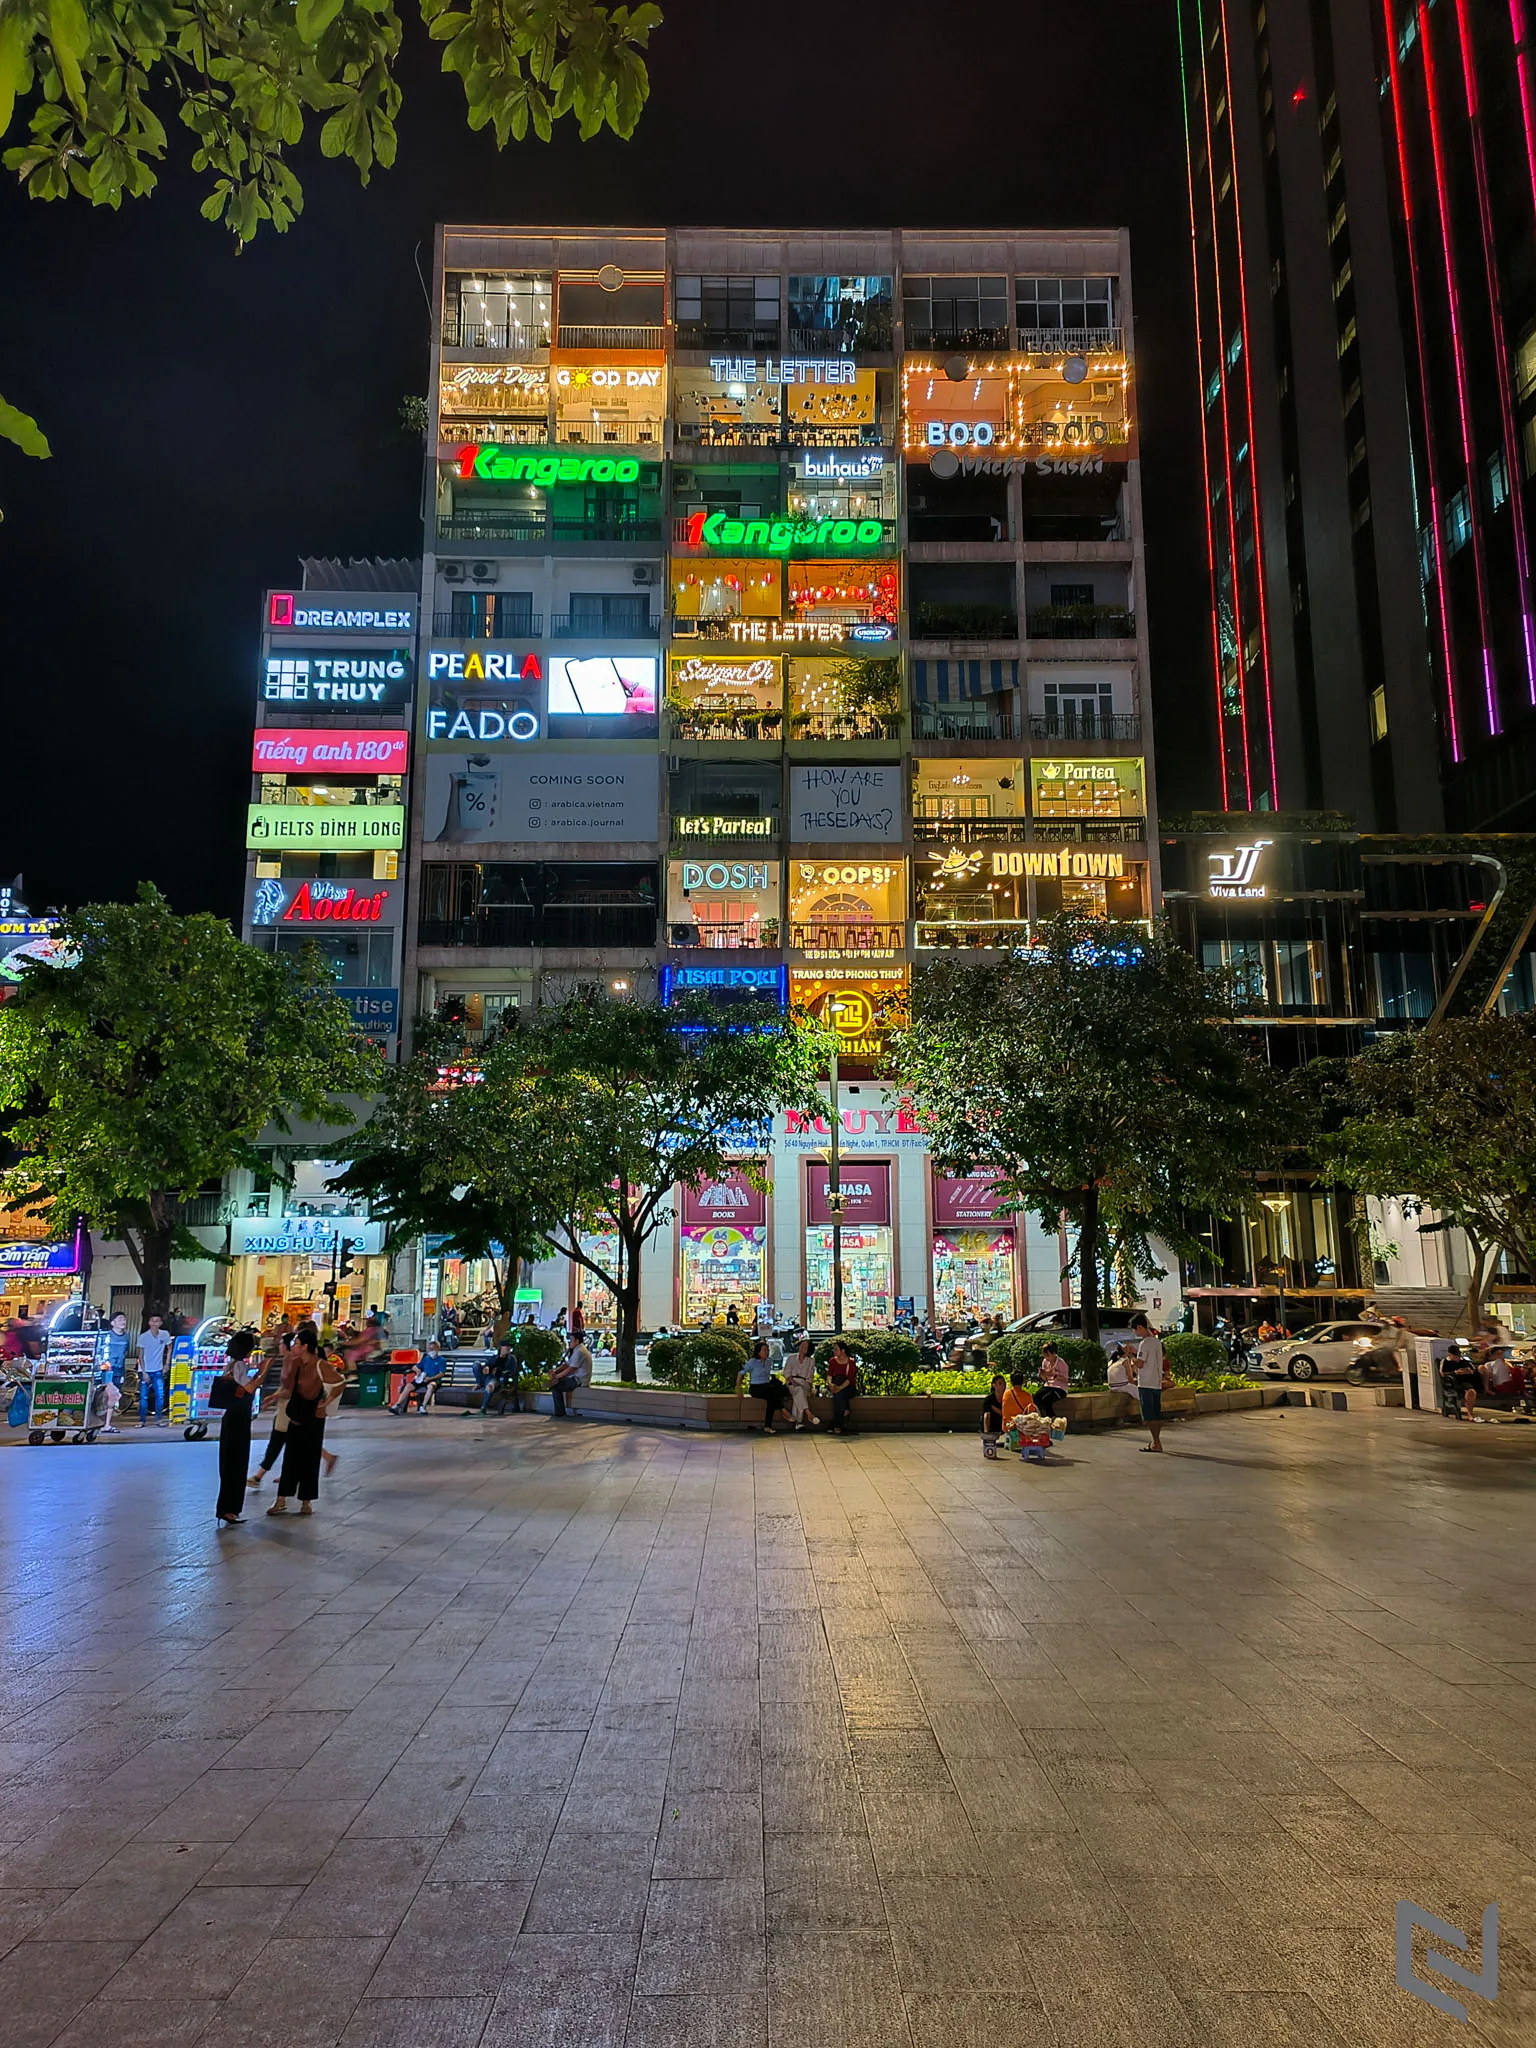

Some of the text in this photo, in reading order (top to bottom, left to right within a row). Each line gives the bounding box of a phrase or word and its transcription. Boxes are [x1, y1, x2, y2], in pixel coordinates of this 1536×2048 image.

[454, 367, 546, 388] Good Days
[631, 371, 665, 387] DAY
[710, 360, 855, 384] THE LETTER
[926, 421, 992, 447] BOO
[1041, 422, 1107, 446] BOO
[804, 454, 870, 477] buihaus
[962, 453, 1102, 477] Michi Sushi
[294, 610, 411, 628] DREAMPLEX
[730, 621, 848, 643] THE LETTER
[314, 660, 405, 679] TRUNG
[428, 652, 543, 681] PEARLA
[312, 682, 387, 701] THUY
[428, 710, 539, 740] FADO
[256, 737, 308, 765] Tiếng
[530, 775, 625, 786] COMING SOON
[802, 770, 885, 791] HOW ARE
[1064, 763, 1116, 780] Partea
[832, 788, 862, 809] YOU
[274, 821, 315, 837] IELTS
[362, 821, 402, 837] LONG
[805, 808, 894, 836] THESE DAYS?
[683, 863, 769, 890] DOSH
[821, 866, 891, 885] OOPS!
[283, 882, 383, 921] Aodai
[311, 882, 347, 900] Miss
[1210, 885, 1265, 898] Viva Land
[729, 969, 777, 986] POKI
[792, 970, 824, 980] TRANG
[845, 970, 879, 980] PHONG
[823, 1183, 872, 1196] FHASA
[712, 1211, 736, 1219] BOOKS
[245, 1236, 366, 1252] XING FU TAG
[956, 1230, 988, 1251] 46
